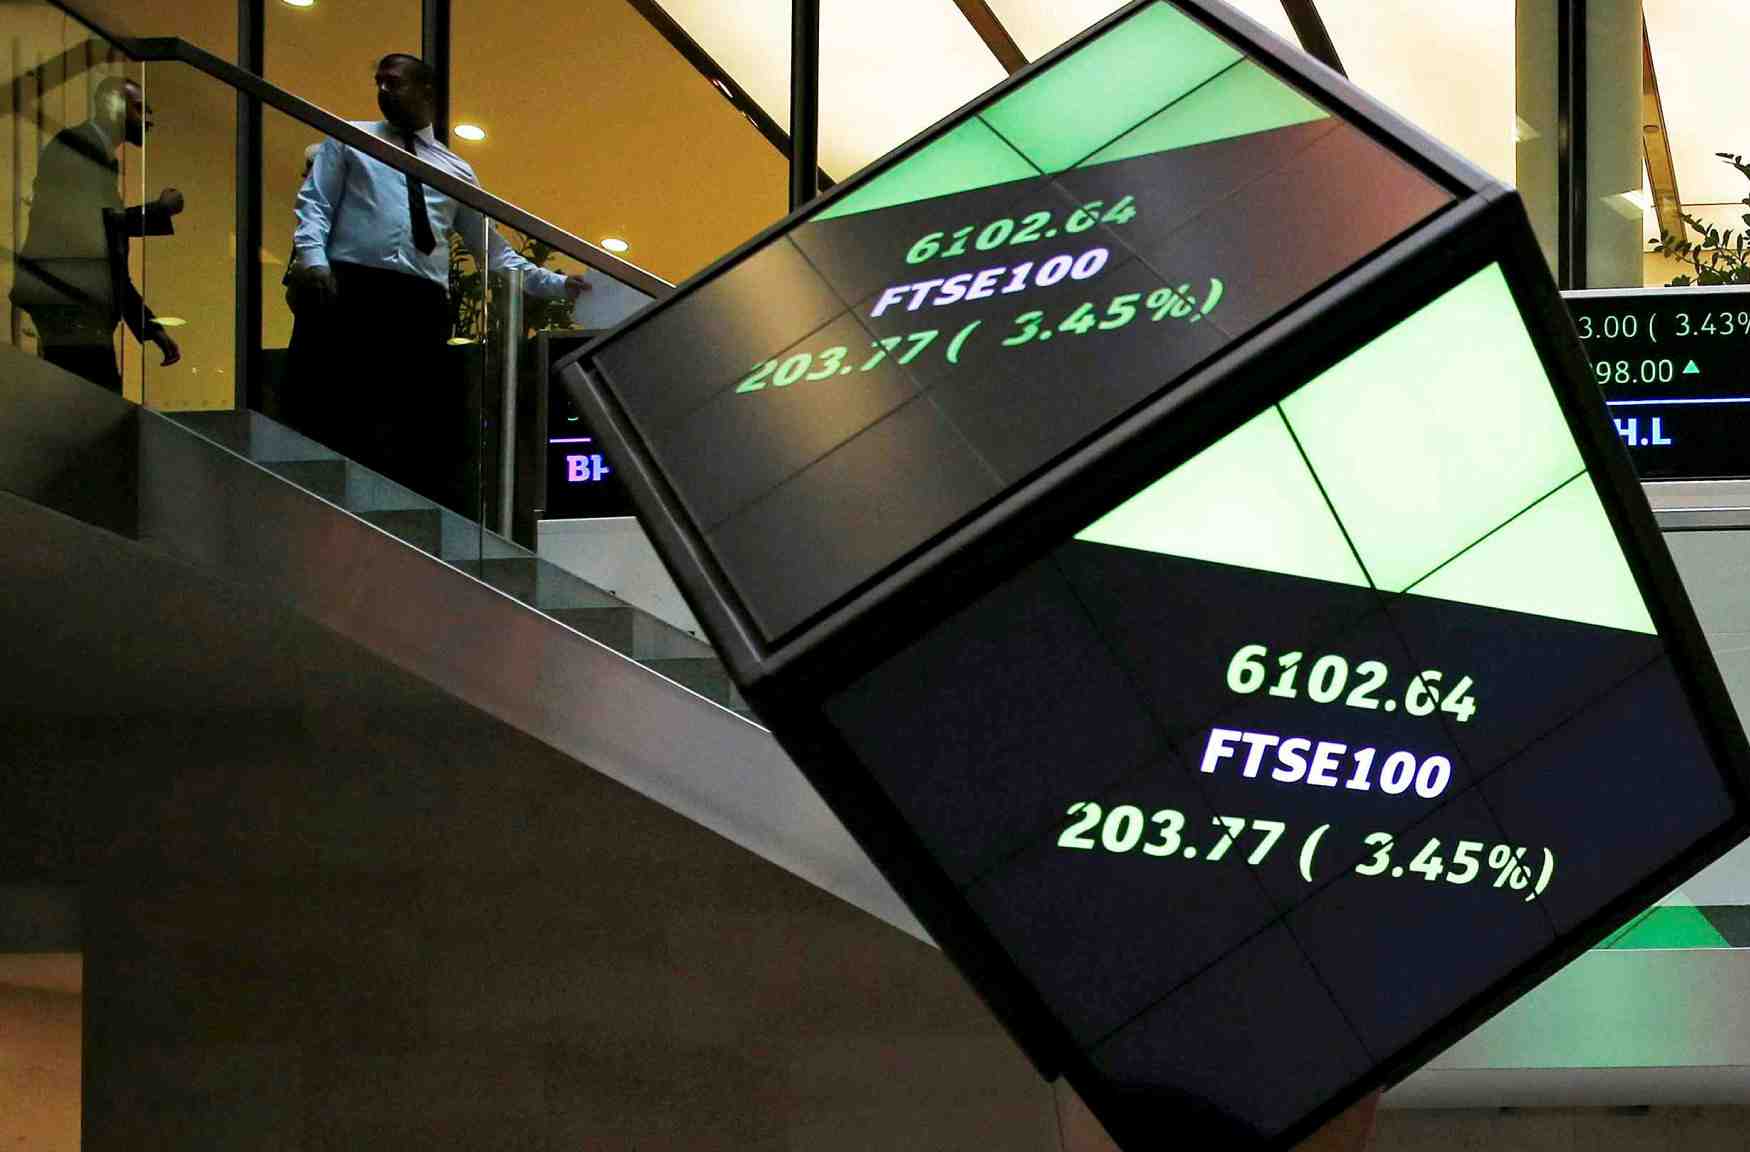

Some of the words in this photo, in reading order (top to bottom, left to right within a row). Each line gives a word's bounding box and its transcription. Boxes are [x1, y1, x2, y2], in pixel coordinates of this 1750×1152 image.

[906, 195, 1137, 265] 6102.64
[868, 247, 1112, 318] FTSE100
[736, 331, 940, 393] 203.77
[1001, 277, 1225, 347] 3.45%)
[1579, 315, 1637, 339] 3.00
[1227, 645, 1475, 722] 6102.64
[1200, 727, 1452, 799] FTSE100
[1058, 803, 1285, 864] 203.77
[1356, 832, 1553, 901] 3.45%)
